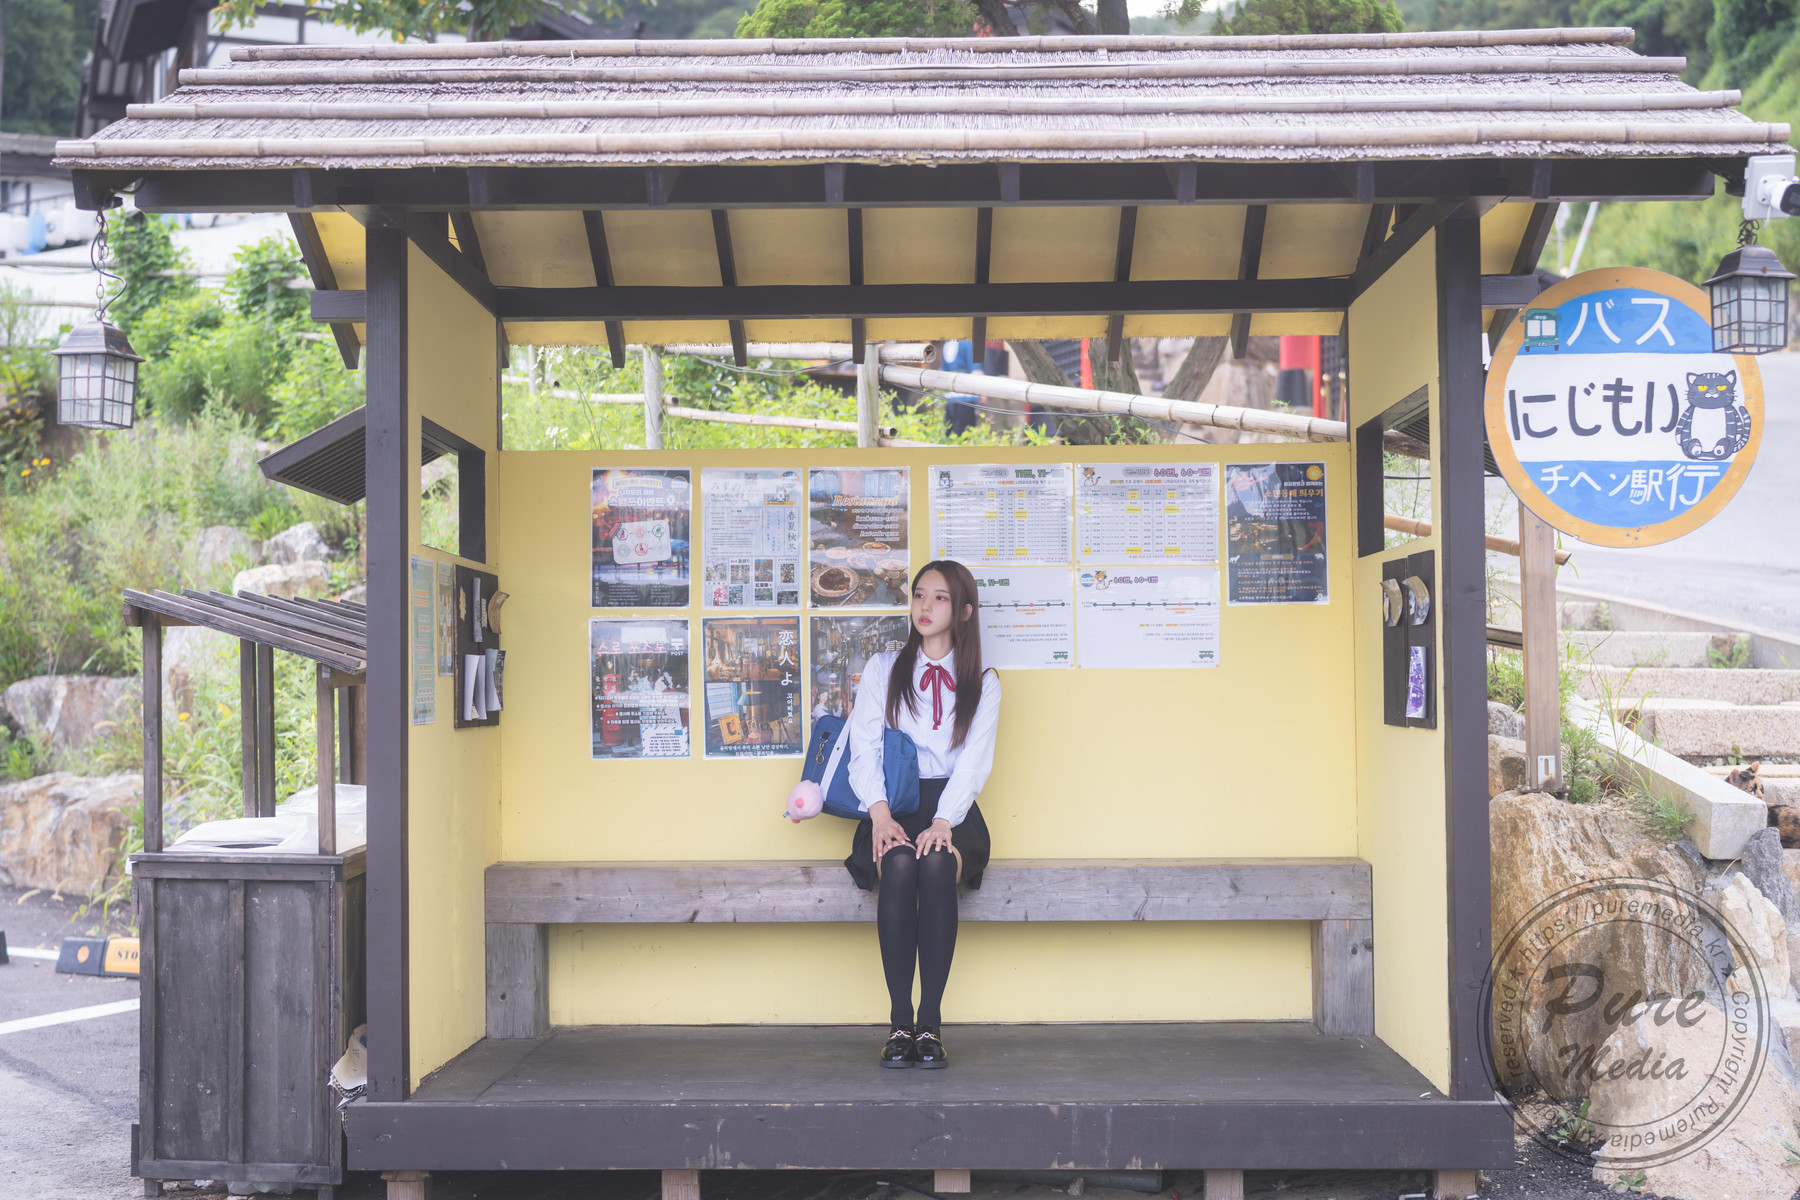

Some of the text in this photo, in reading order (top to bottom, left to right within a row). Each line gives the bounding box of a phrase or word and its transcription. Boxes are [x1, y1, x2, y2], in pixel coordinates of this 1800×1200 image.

[1567, 298, 1675, 346] バス
[1509, 378, 1679, 440] にじもり
[1540, 463, 1720, 511] チヘン駅行
[779, 630, 795, 686] 恋人よ
[117, 950, 139, 960] STO
